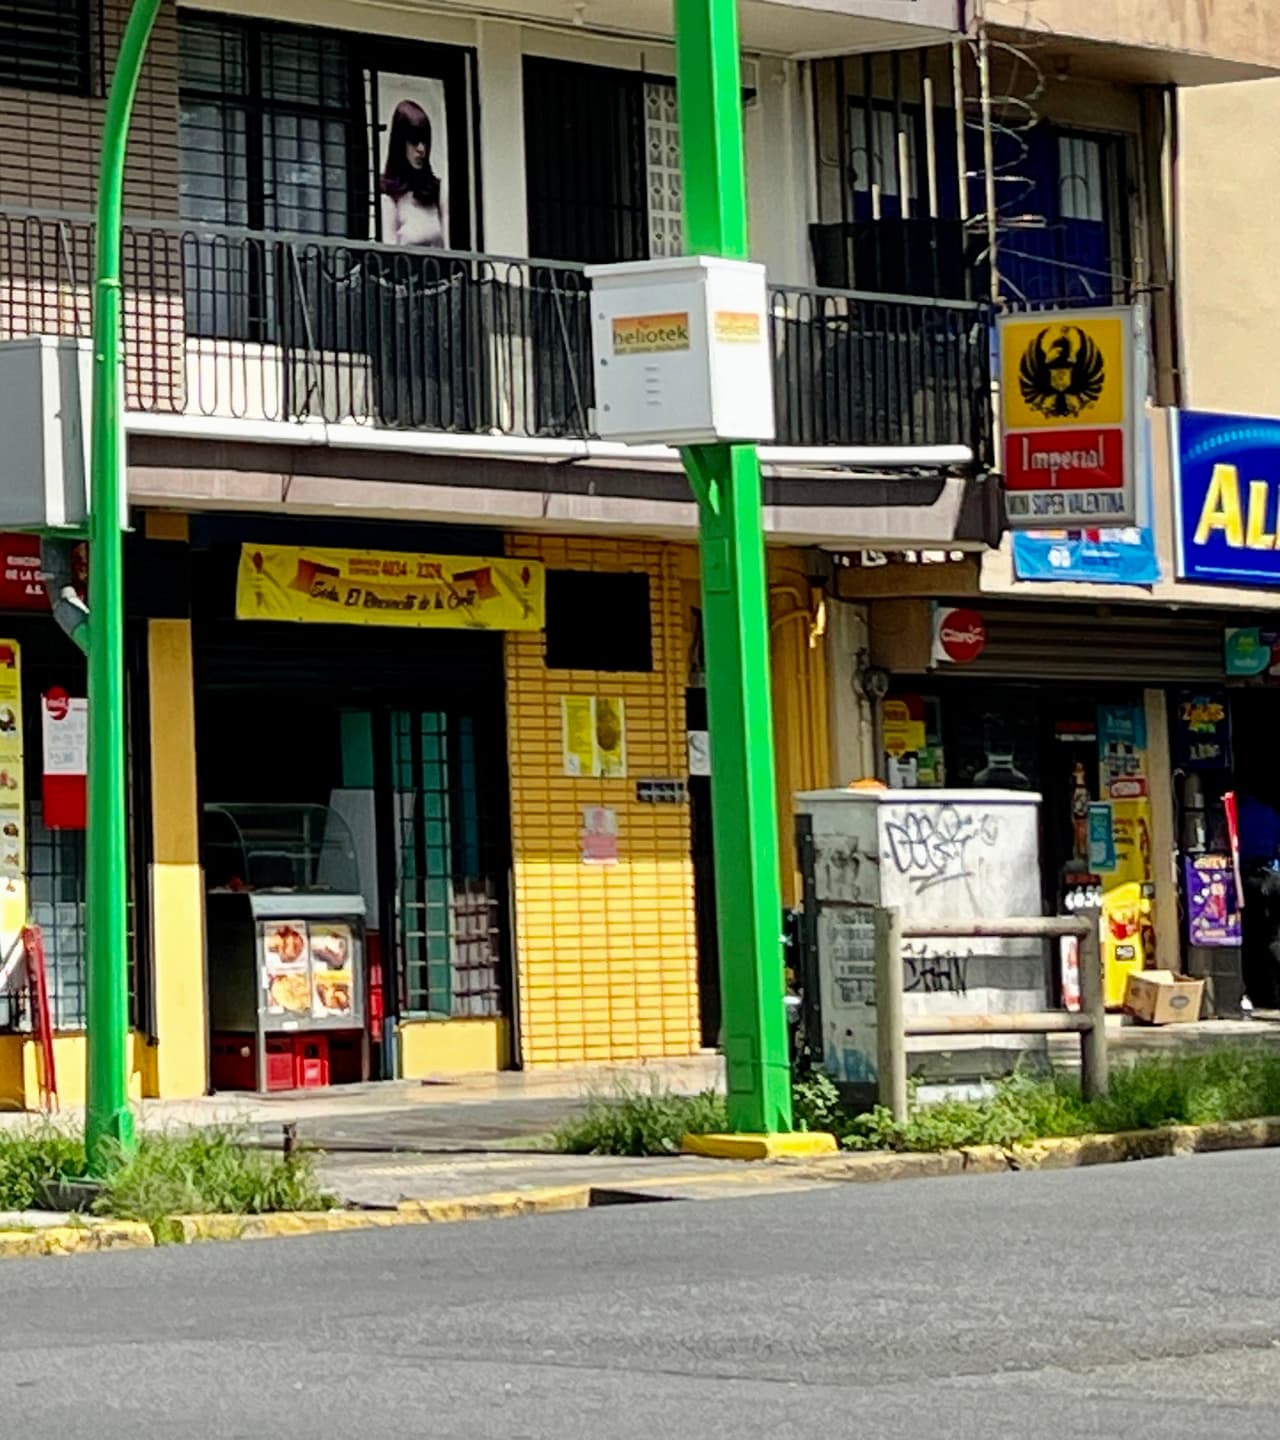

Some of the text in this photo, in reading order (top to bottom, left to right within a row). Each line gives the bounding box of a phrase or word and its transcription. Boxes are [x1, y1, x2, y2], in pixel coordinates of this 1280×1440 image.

[613, 325, 689, 345] heliotek
[1022, 434, 1105, 487] Imperial
[1033, 492, 1065, 514] SUPER
